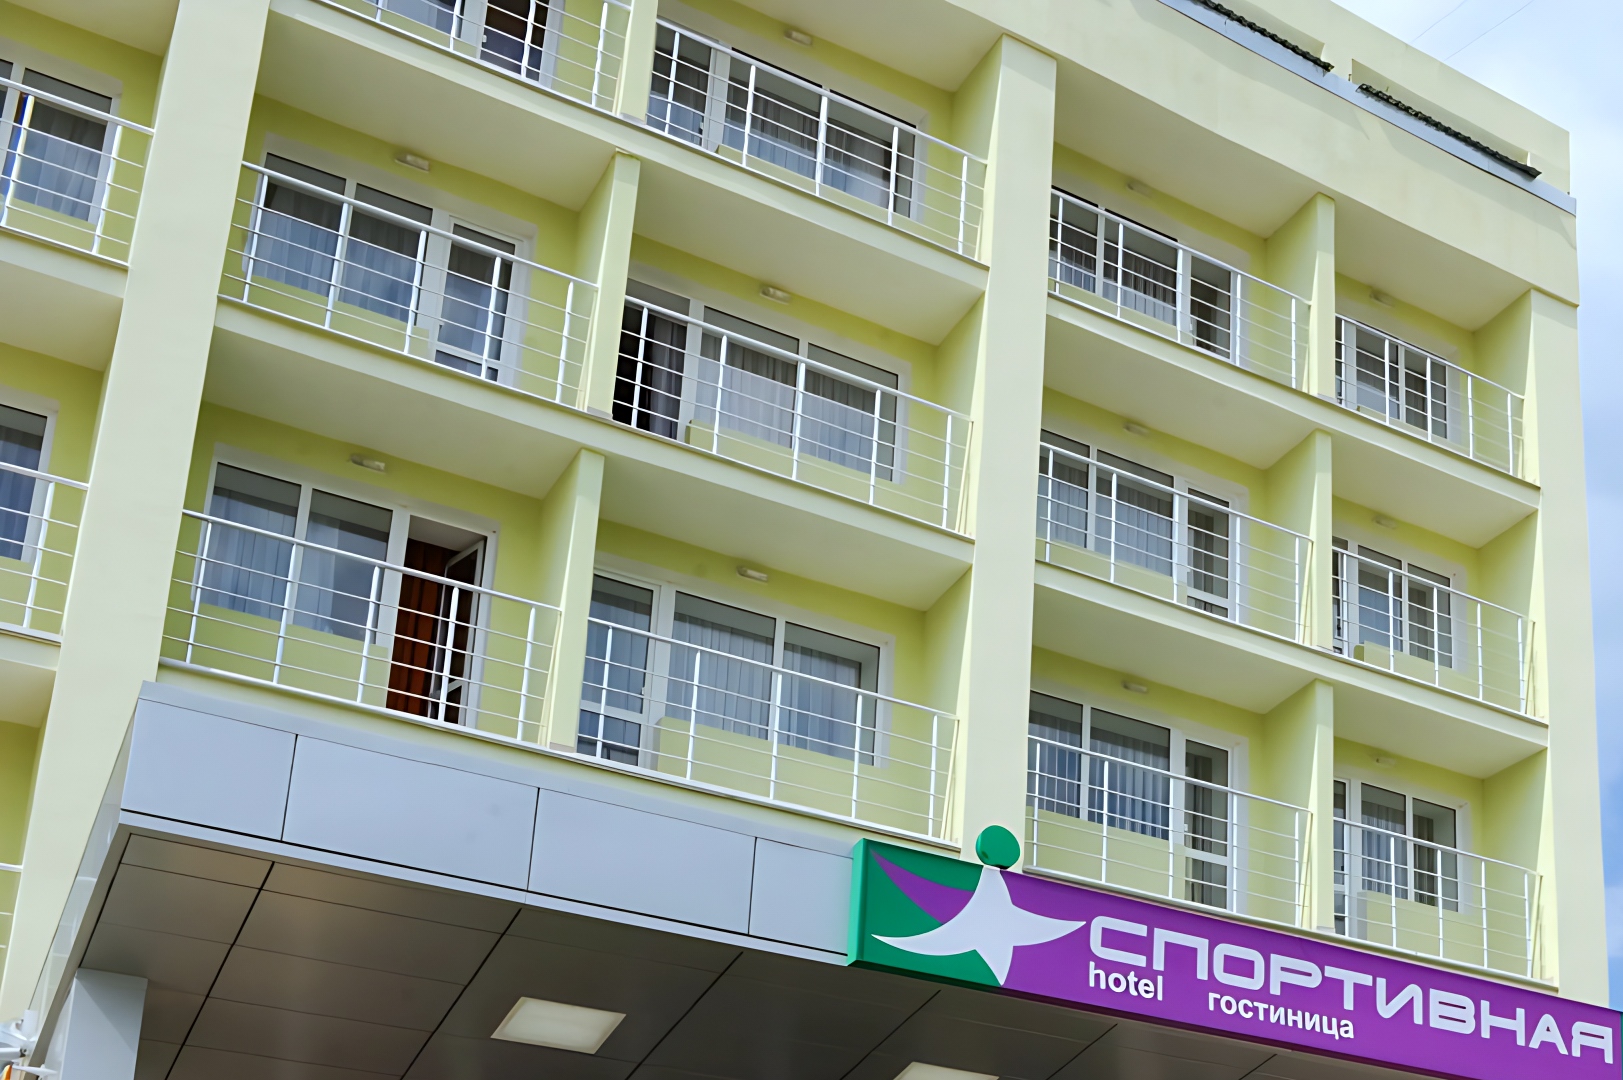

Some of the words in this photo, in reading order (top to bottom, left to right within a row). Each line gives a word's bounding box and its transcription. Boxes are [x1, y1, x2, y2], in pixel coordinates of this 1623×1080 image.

[1088, 961, 1164, 1001] hotel
[1089, 915, 1614, 1065] СПОРТИВНАЯ
[1208, 992, 1355, 1041] гостиница
